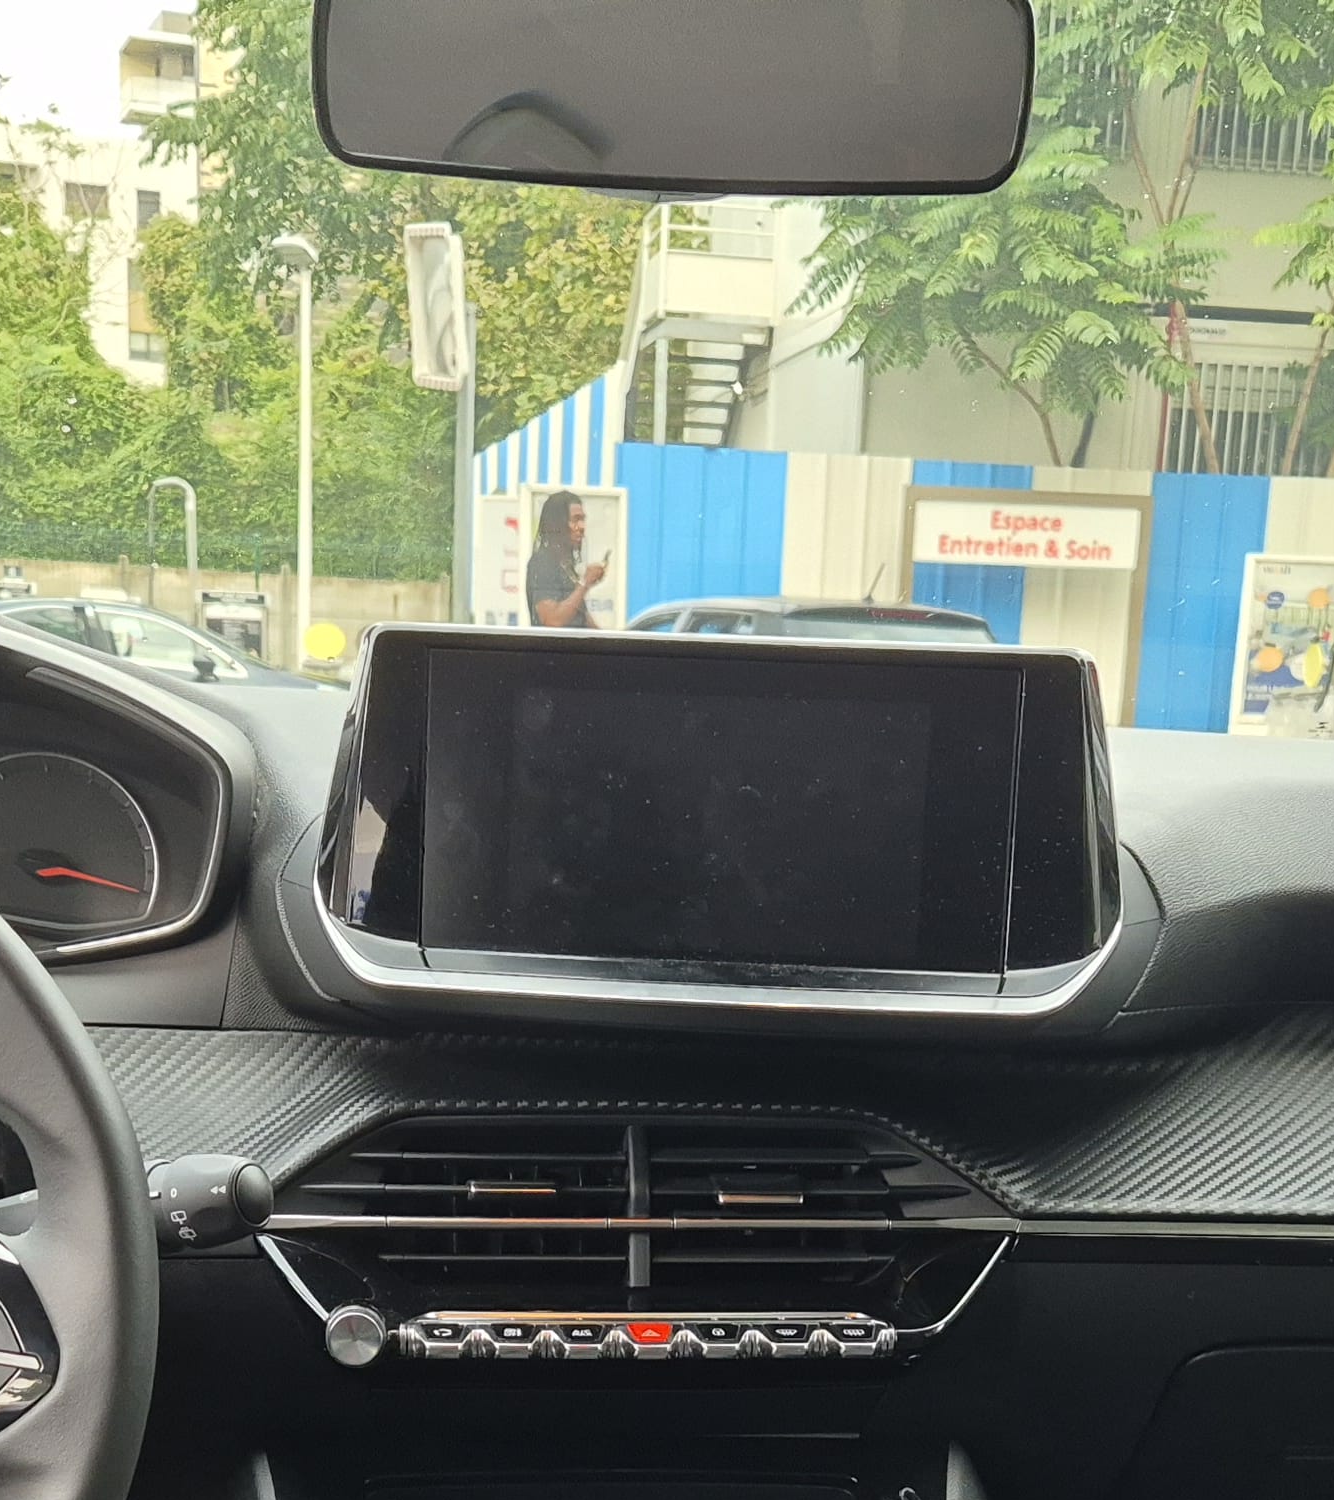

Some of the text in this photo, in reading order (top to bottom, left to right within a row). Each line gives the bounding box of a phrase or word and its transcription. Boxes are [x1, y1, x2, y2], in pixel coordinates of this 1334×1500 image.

[990, 510, 1064, 536] Espace
[938, 534, 1112, 561] Entretien & Soin
